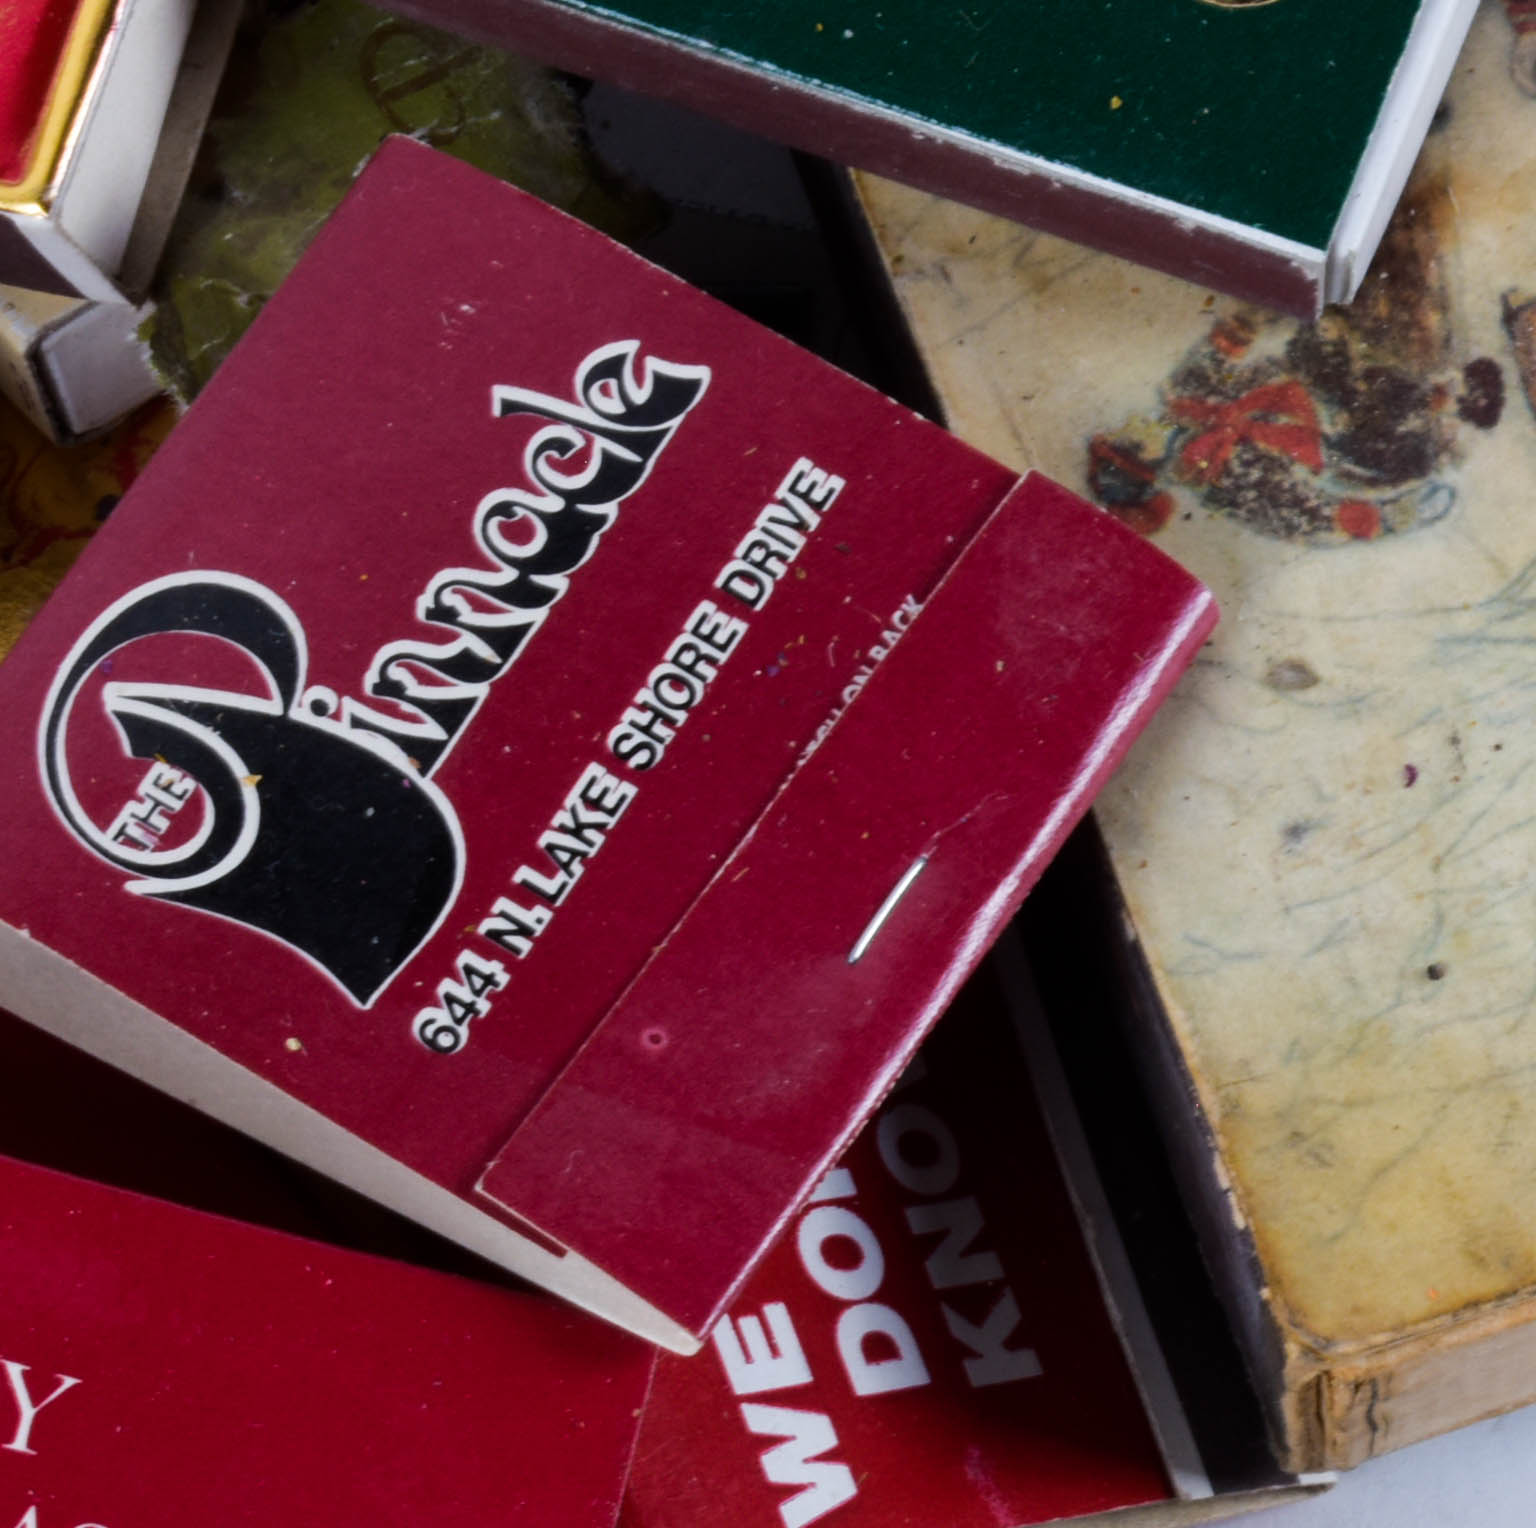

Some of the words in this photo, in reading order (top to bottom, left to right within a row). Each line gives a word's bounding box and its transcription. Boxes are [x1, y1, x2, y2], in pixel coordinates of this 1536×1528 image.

[714, 456, 847, 612] DRIVE
[606, 600, 749, 771] SHORE
[868, 593, 925, 662] BACK
[106, 760, 198, 853] THE
[511, 761, 640, 907] LAKE
[477, 895, 554, 960] N.
[412, 949, 513, 1056] 644
[875, 1055, 1044, 1389] KNO
